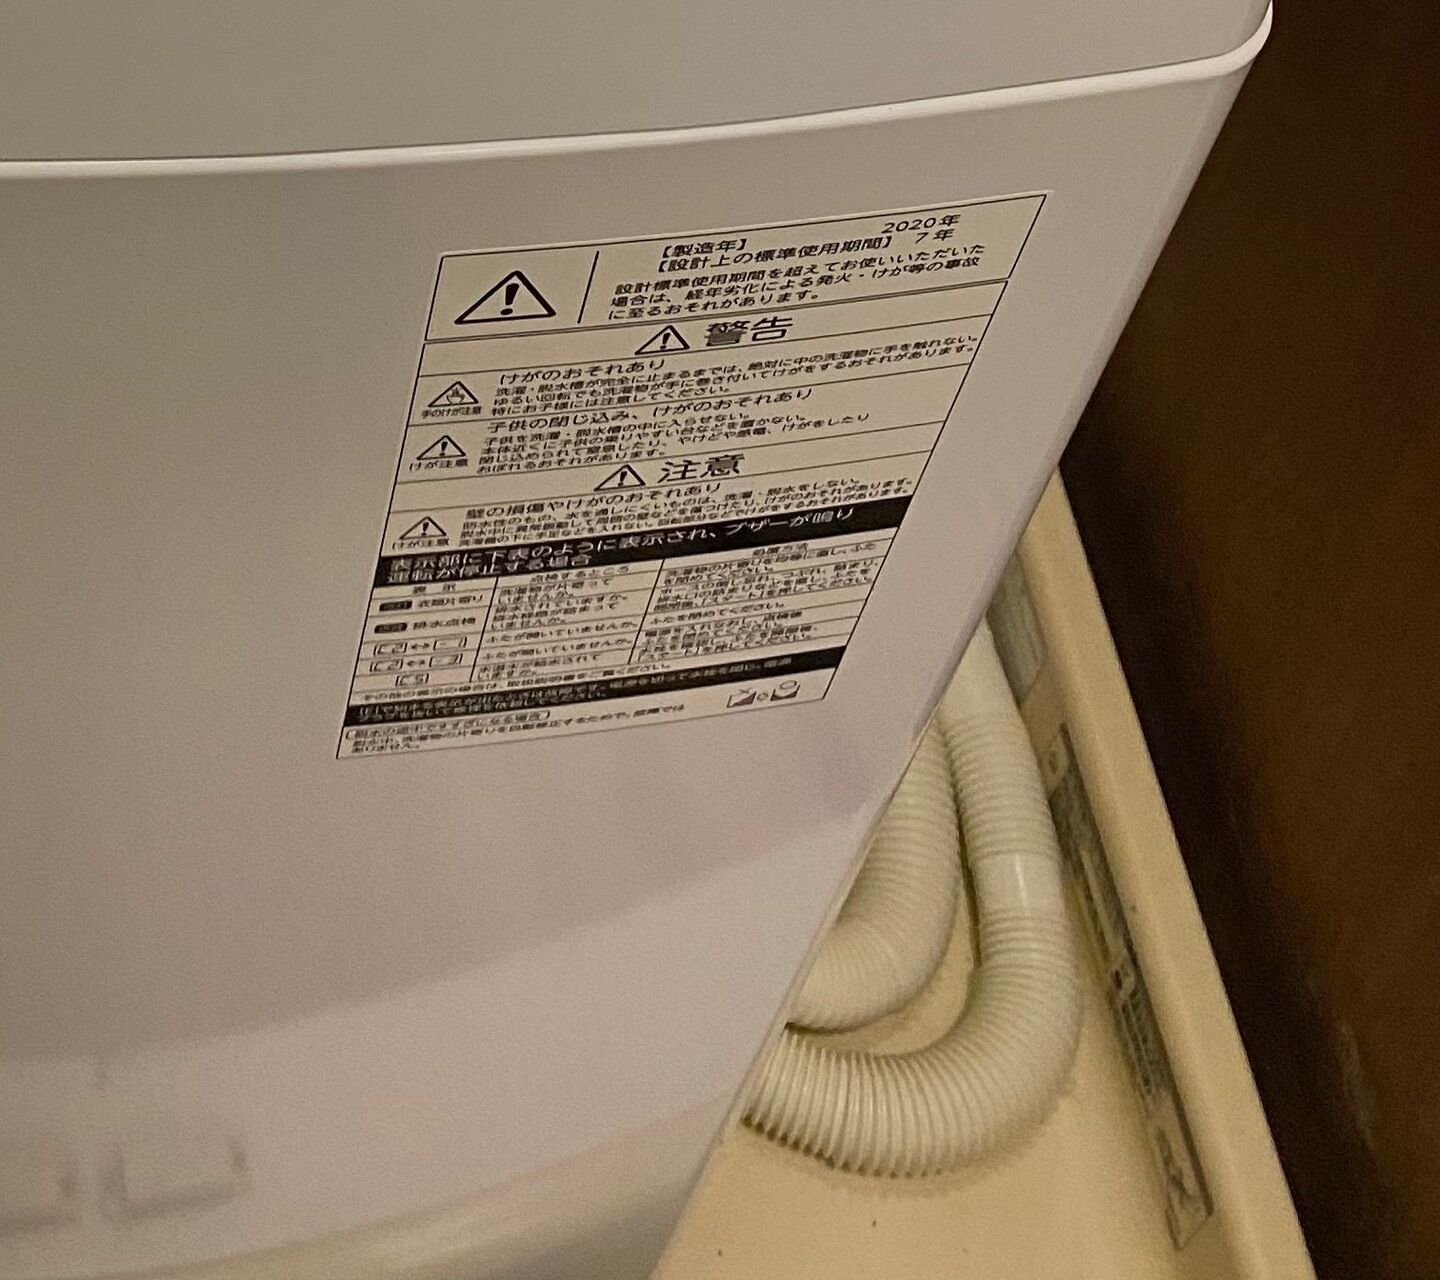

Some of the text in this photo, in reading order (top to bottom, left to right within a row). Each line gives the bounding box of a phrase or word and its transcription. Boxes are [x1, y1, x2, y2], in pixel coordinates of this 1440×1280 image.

[880, 213, 961, 233] 2020年
[607, 289, 820, 320] に至るおそれがあります。
[700, 314, 796, 347] 警告
[498, 357, 666, 386] けがのおそれあり
[657, 452, 746, 482] 注意
